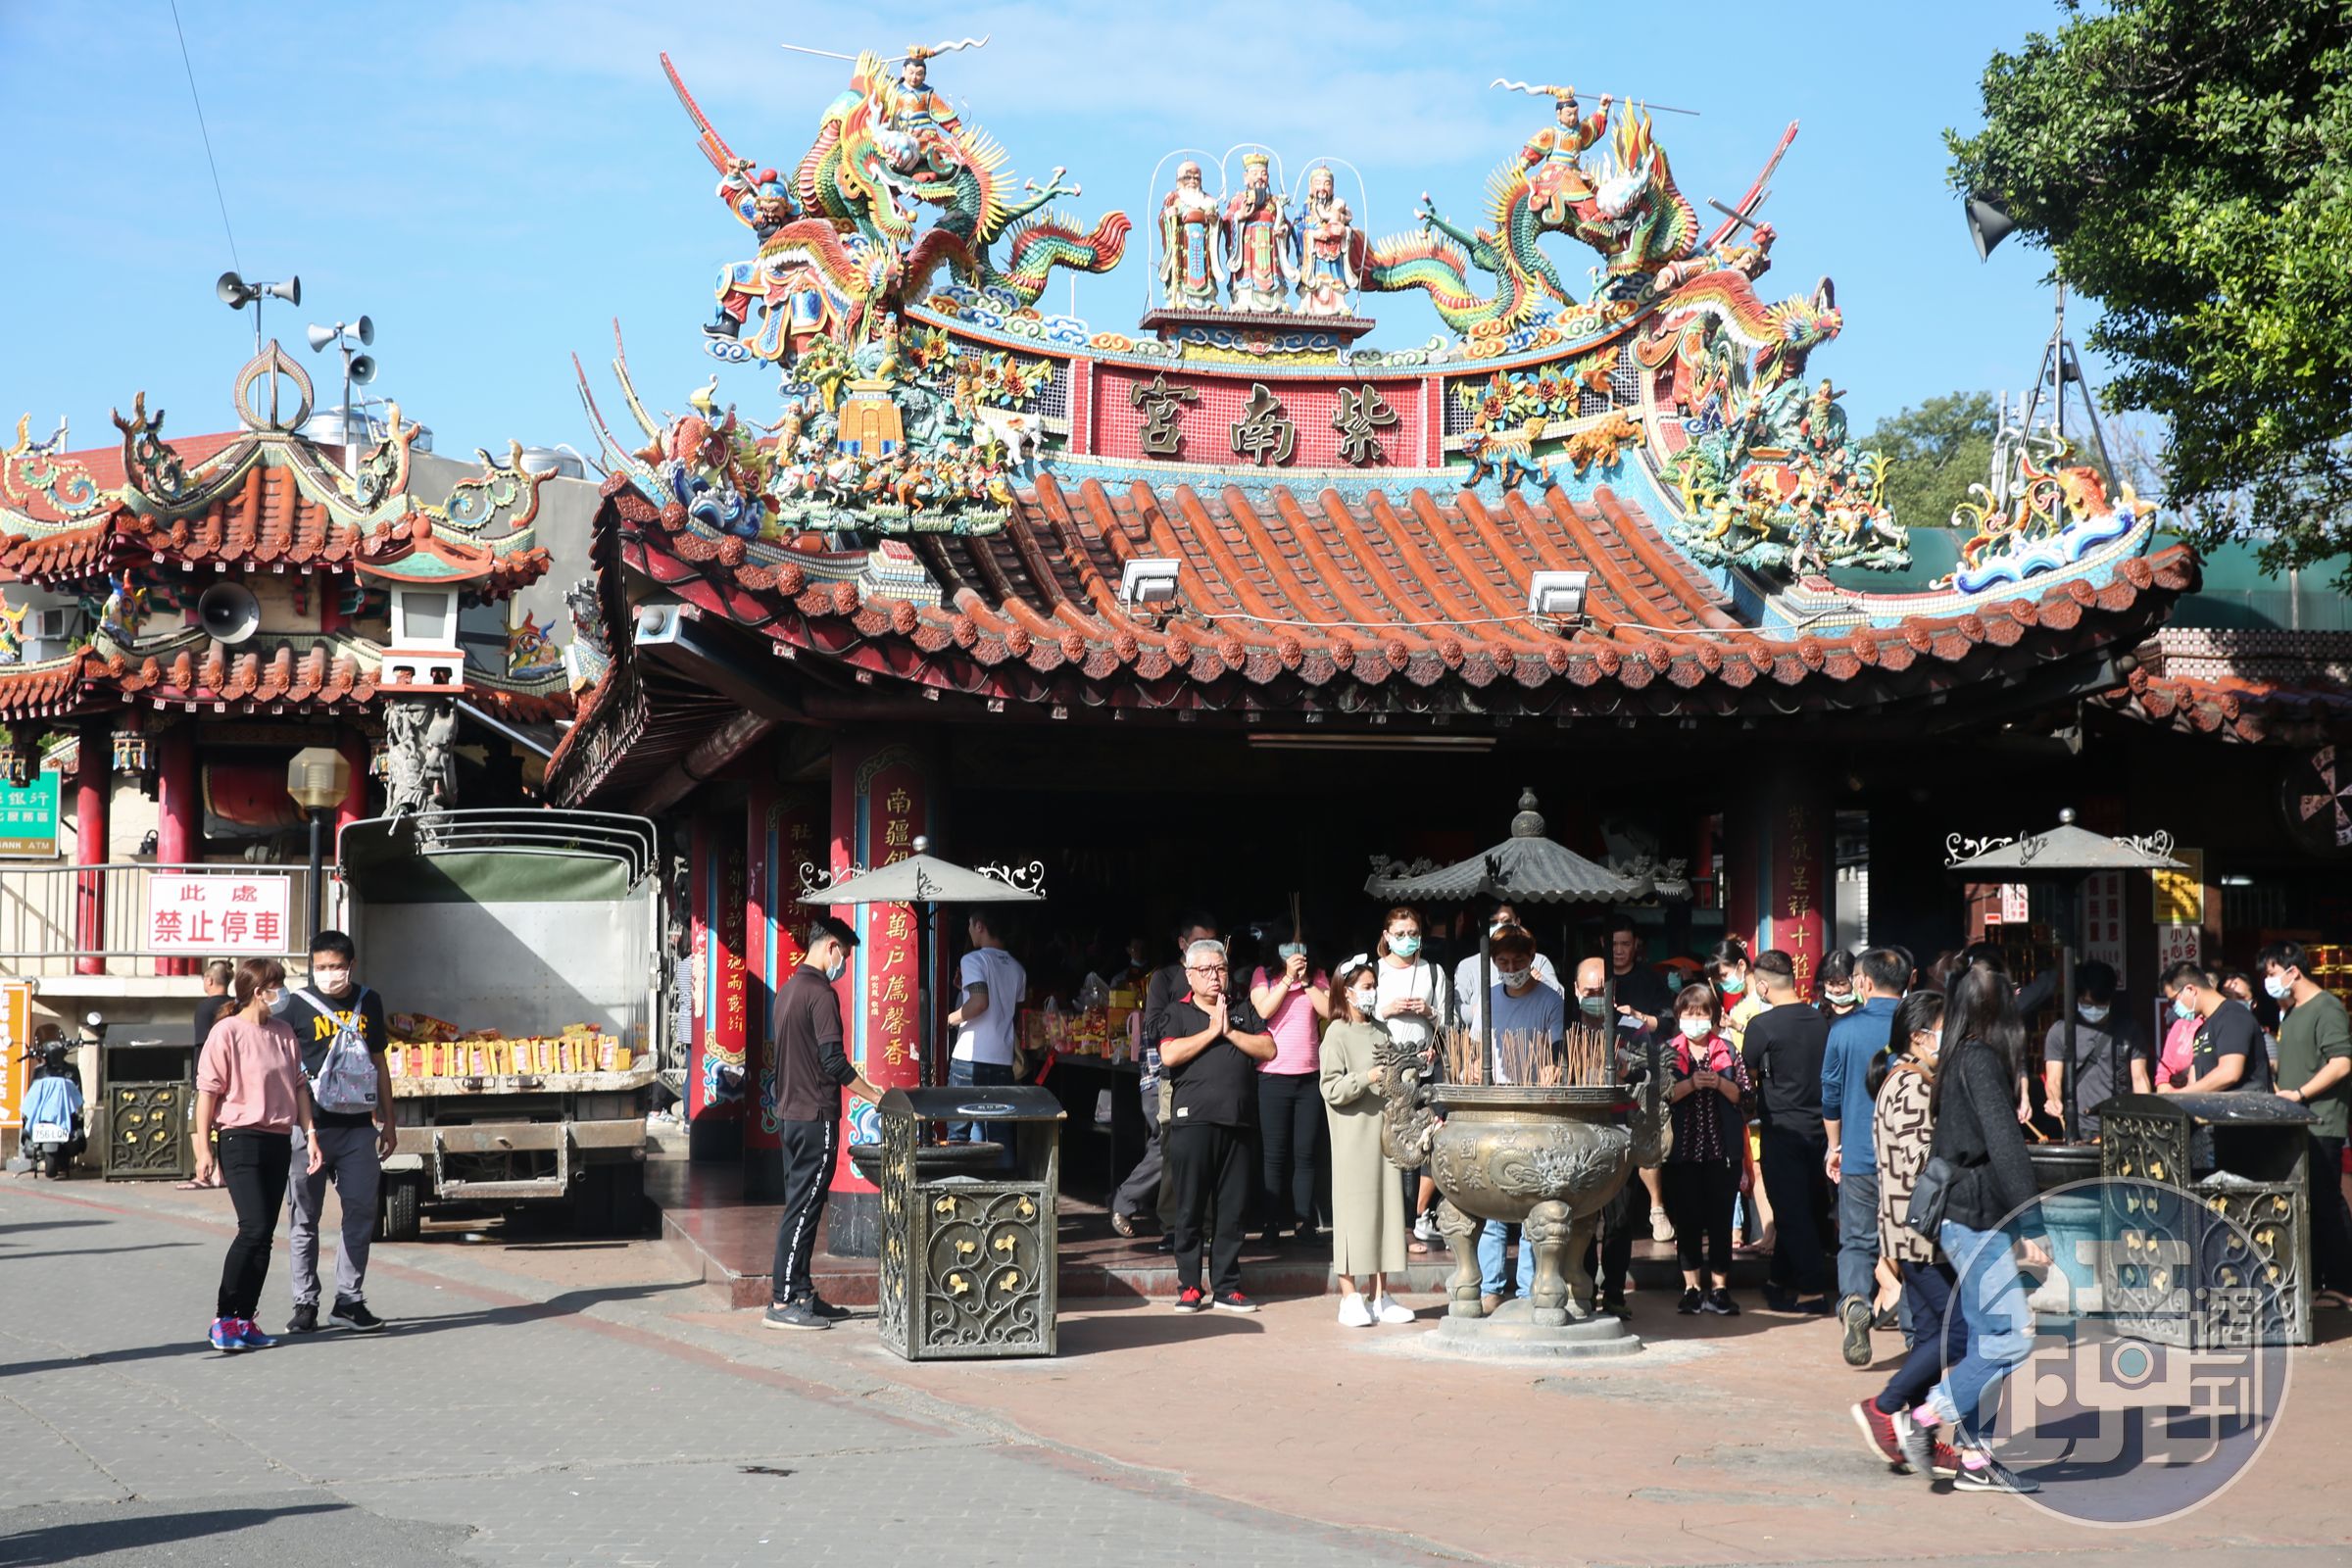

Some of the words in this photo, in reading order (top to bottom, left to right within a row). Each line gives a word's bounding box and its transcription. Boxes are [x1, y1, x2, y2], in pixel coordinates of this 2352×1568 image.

[1129, 375, 1398, 466] 紫南宮
[0, 791, 50, 807] 銀行
[0, 841, 22, 850] ANK
[27, 841, 50, 850] ATM
[180, 884, 258, 902] 此處
[154, 909, 280, 943] 禁止停車
[881, 787, 911, 1066] 南疆萬戶薦馨香
